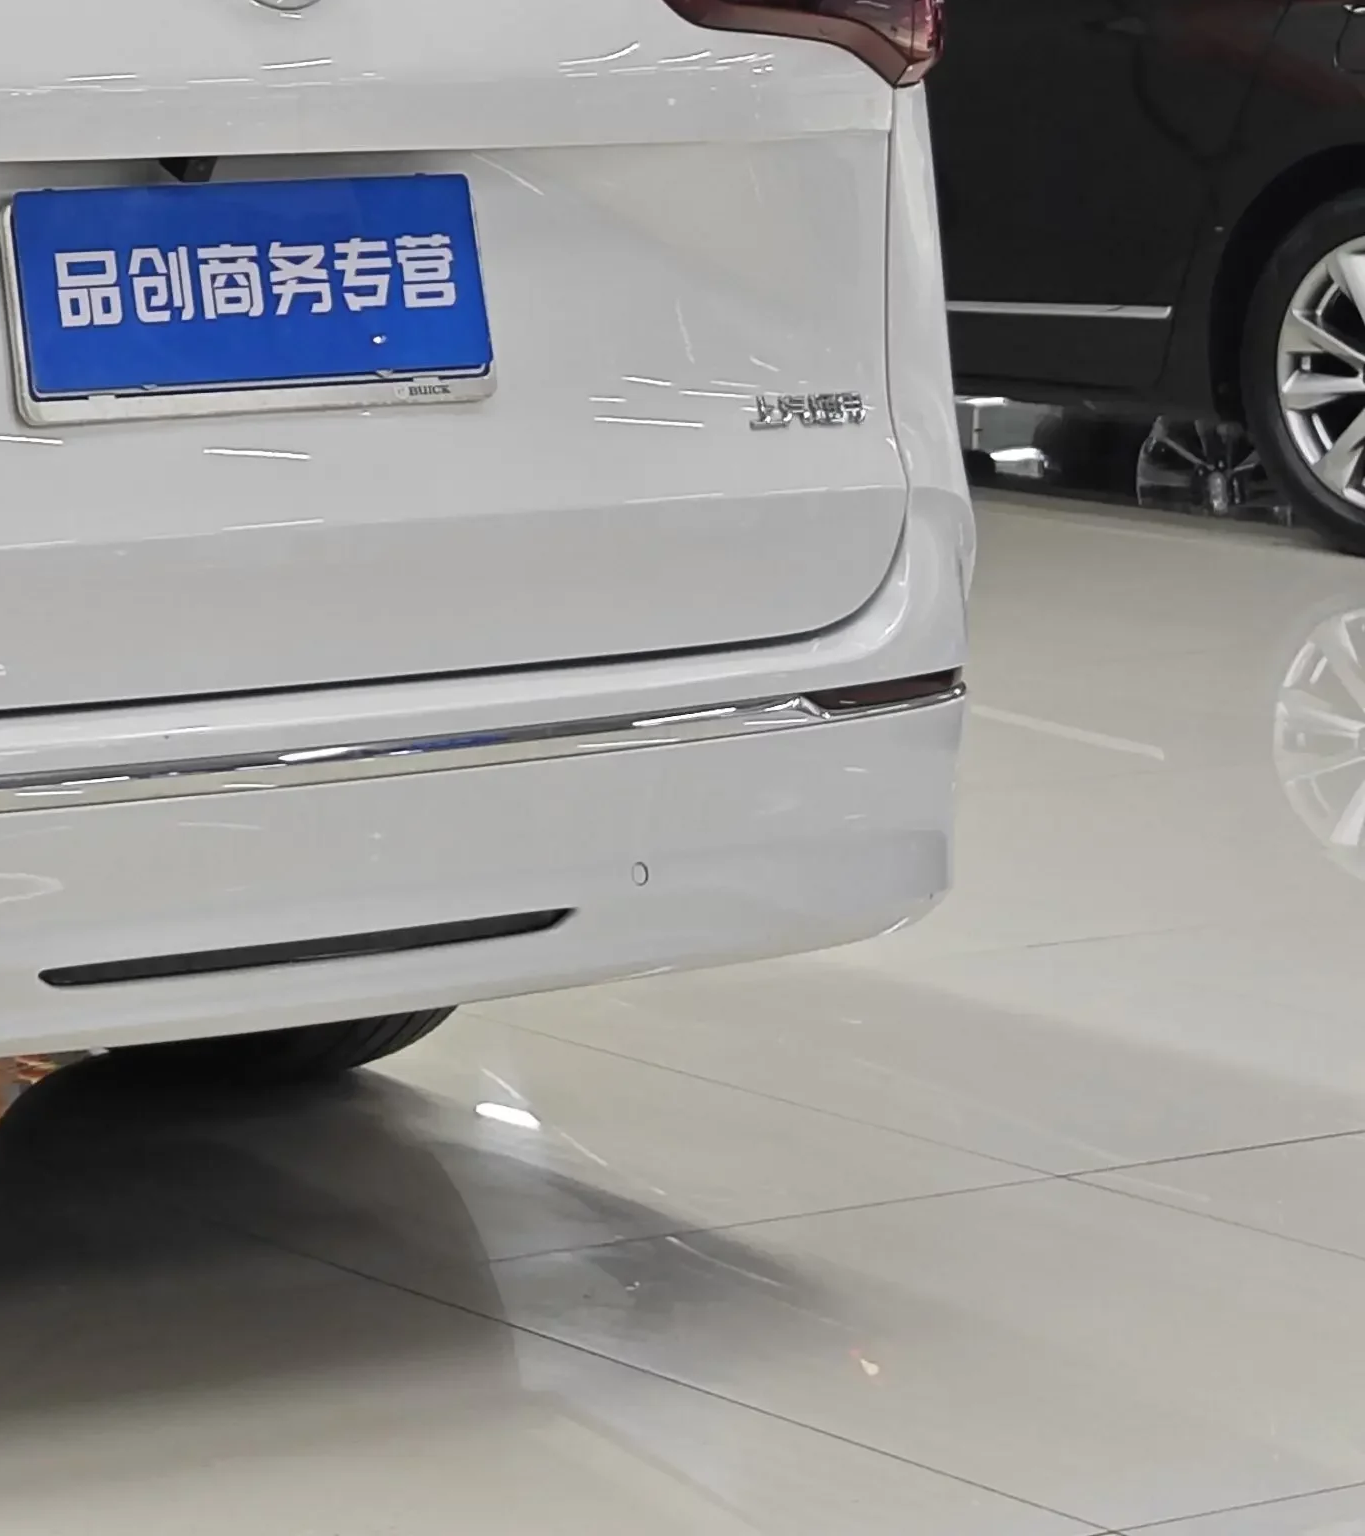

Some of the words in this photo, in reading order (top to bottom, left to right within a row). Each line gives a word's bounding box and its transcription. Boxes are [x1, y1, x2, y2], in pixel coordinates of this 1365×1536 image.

[53, 233, 458, 329] 品创商务专营
[408, 384, 451, 396] BUICK
